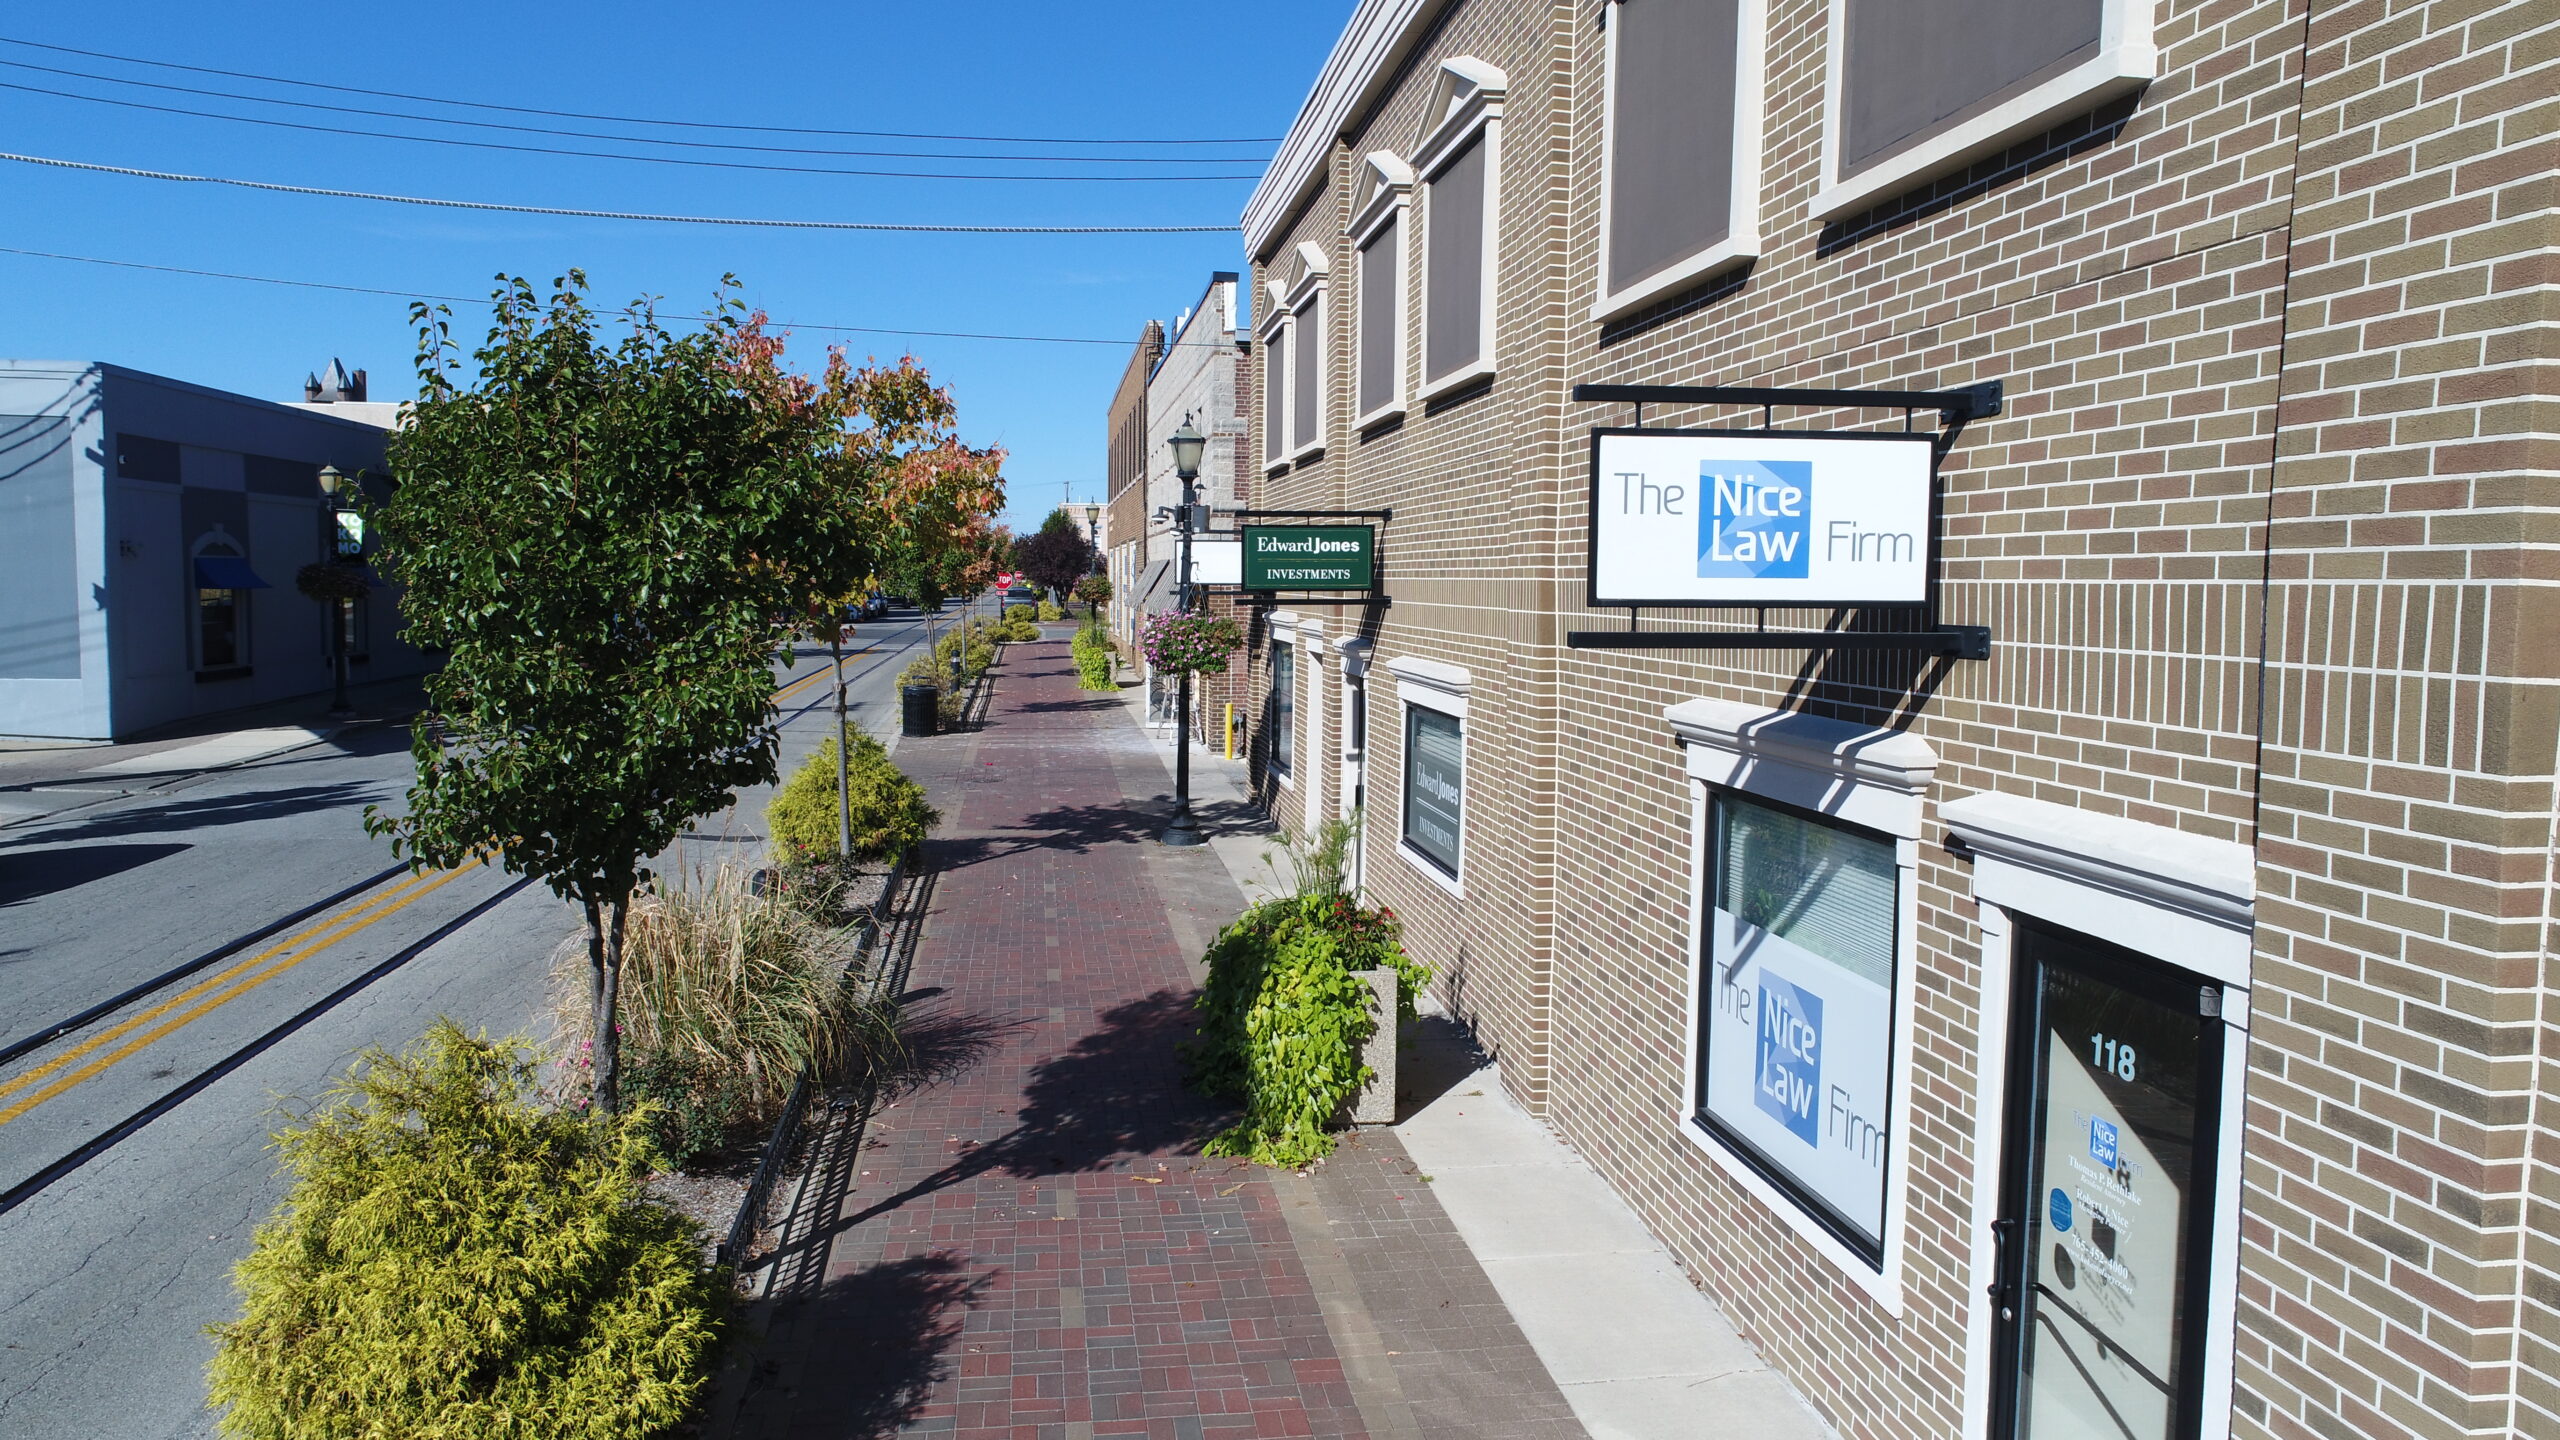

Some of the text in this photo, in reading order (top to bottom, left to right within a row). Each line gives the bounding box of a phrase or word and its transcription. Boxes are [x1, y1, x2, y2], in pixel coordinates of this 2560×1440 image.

[1613, 472, 1803, 517] The Nice
[337, 528, 361, 540] KO
[338, 542, 361, 554] MO
[1711, 519, 1913, 563] Law Firm
[1267, 569, 1351, 580] INVESTMENTS
[1419, 815, 1454, 853] INVESTMENTS
[1717, 961, 1816, 1066] The Nice
[2091, 1032, 2136, 1083] 118
[1762, 1041, 1814, 1120] Law
[2073, 1108, 2116, 1146] The Nice
[2092, 1137, 2115, 1162] Law
[2068, 1154, 2098, 1181] Thomas
[2106, 1178, 2142, 1206] Rethlake
[2076, 1187, 2104, 1211] Robert
[2111, 1209, 2129, 1228] Nice
[2071, 1233, 2129, 1280] 765-452-4000
